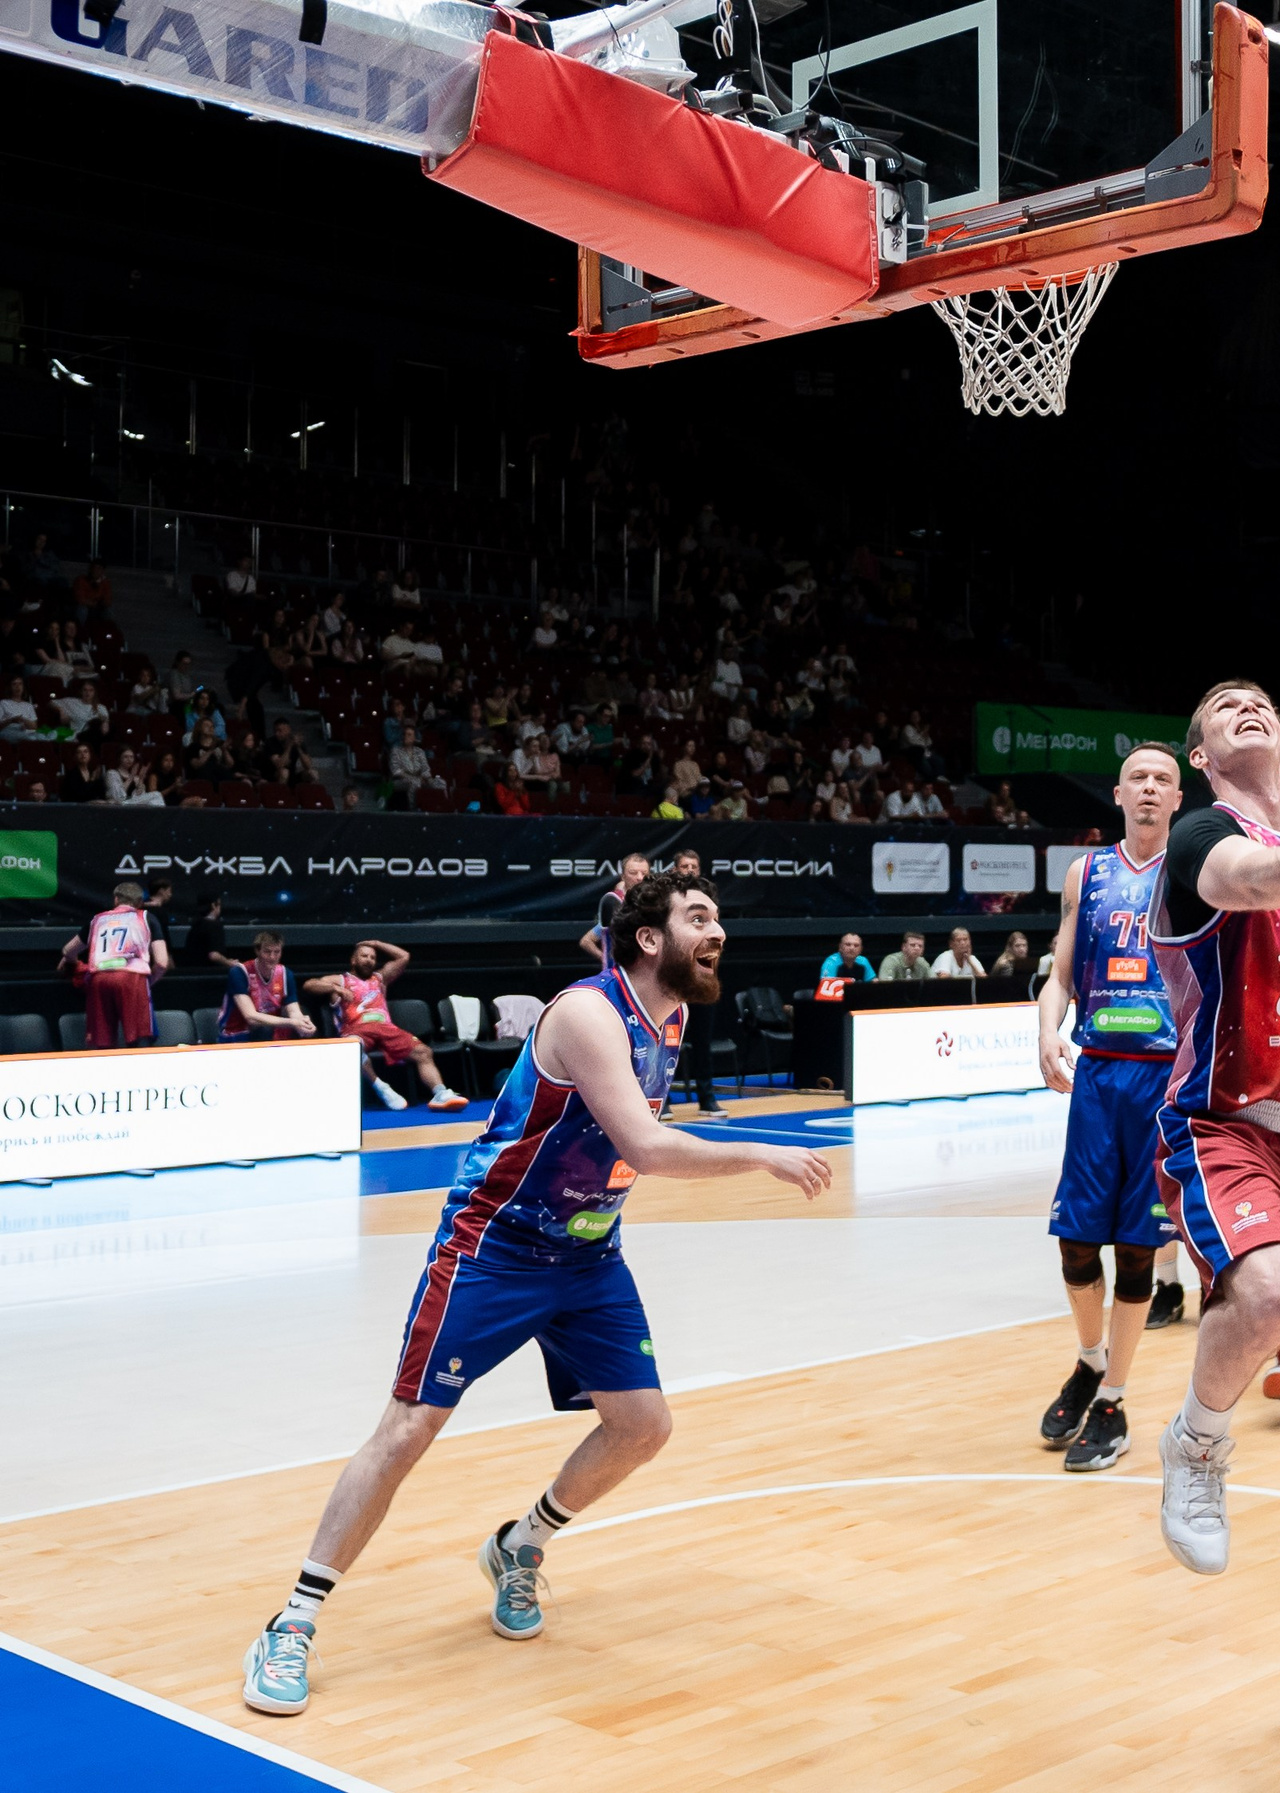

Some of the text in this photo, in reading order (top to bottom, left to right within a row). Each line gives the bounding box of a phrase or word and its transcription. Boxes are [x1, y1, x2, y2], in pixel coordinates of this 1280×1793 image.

[50, 0, 430, 134] GARED
[0, 855, 41, 870] ФОН
[308, 856, 488, 876] НАРОДОВ
[711, 858, 833, 876] РОССИИ
[99, 927, 128, 953] 17
[1109, 910, 1148, 950] 71
[1110, 1014, 1157, 1025] МЕГАФОН
[958, 1030, 1037, 1052] РОСКОНГ
